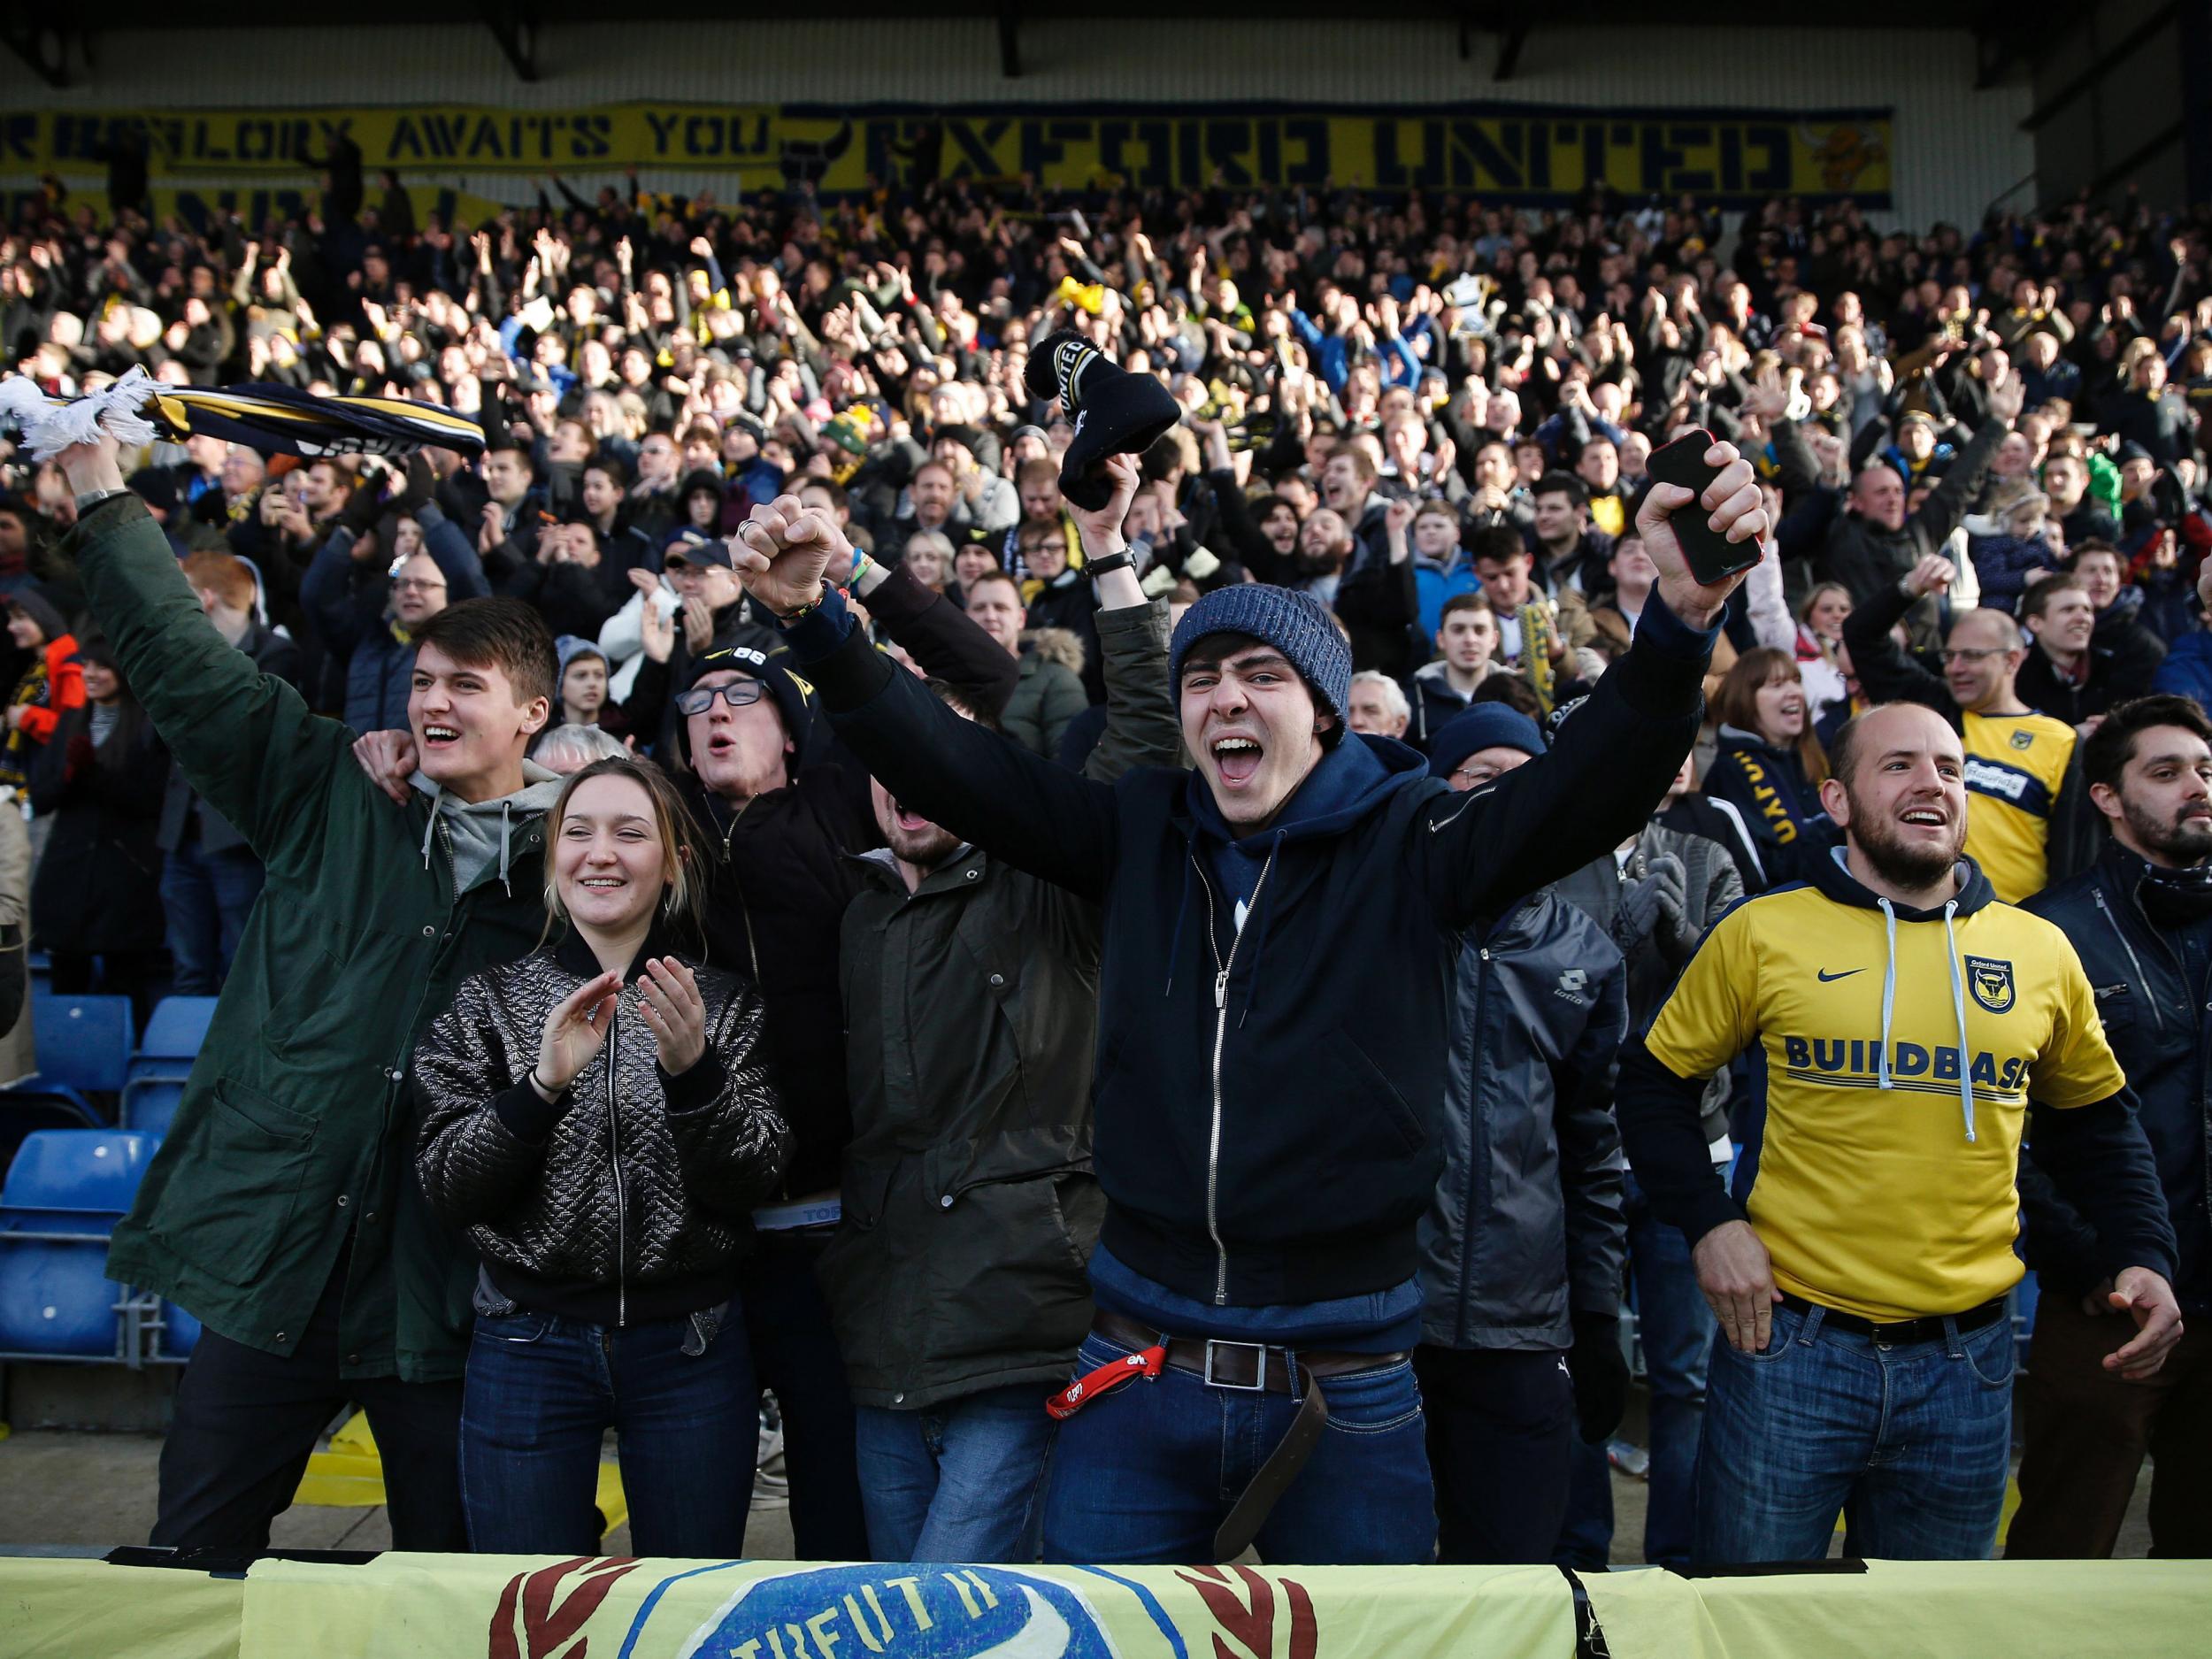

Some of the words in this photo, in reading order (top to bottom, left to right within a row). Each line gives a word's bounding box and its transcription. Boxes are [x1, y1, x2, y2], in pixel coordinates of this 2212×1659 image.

[388, 114, 612, 160] AWAITS
[645, 111, 771, 155] YOU
[1373, 120, 1793, 190] UNITED
[1060, 342, 1086, 411] UNITED
